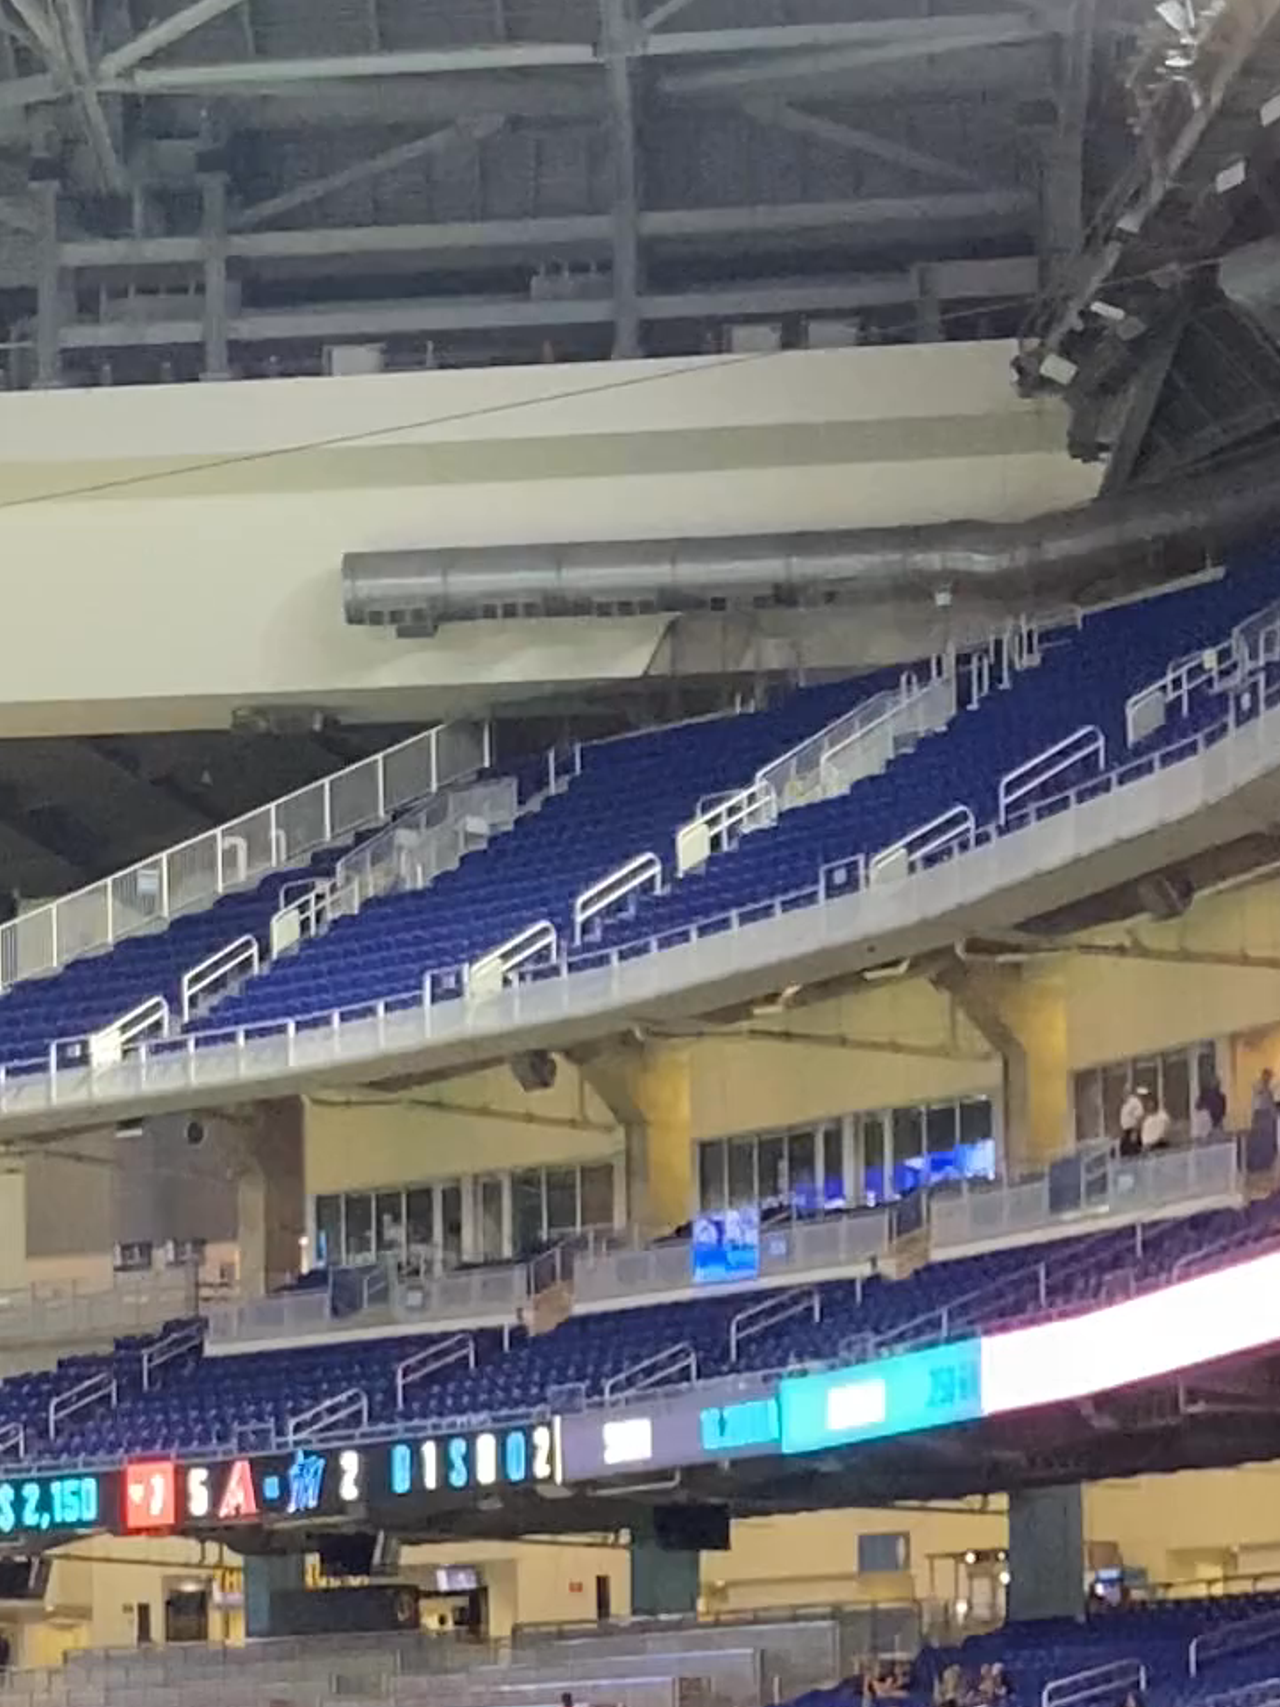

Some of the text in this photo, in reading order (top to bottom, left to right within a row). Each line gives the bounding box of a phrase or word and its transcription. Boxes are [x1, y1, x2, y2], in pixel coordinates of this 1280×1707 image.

[188, 1467, 209, 1517] 5
[340, 1450, 359, 1501] 2
[422, 1440, 437, 1490] 1
[533, 1426, 552, 1479] 2
